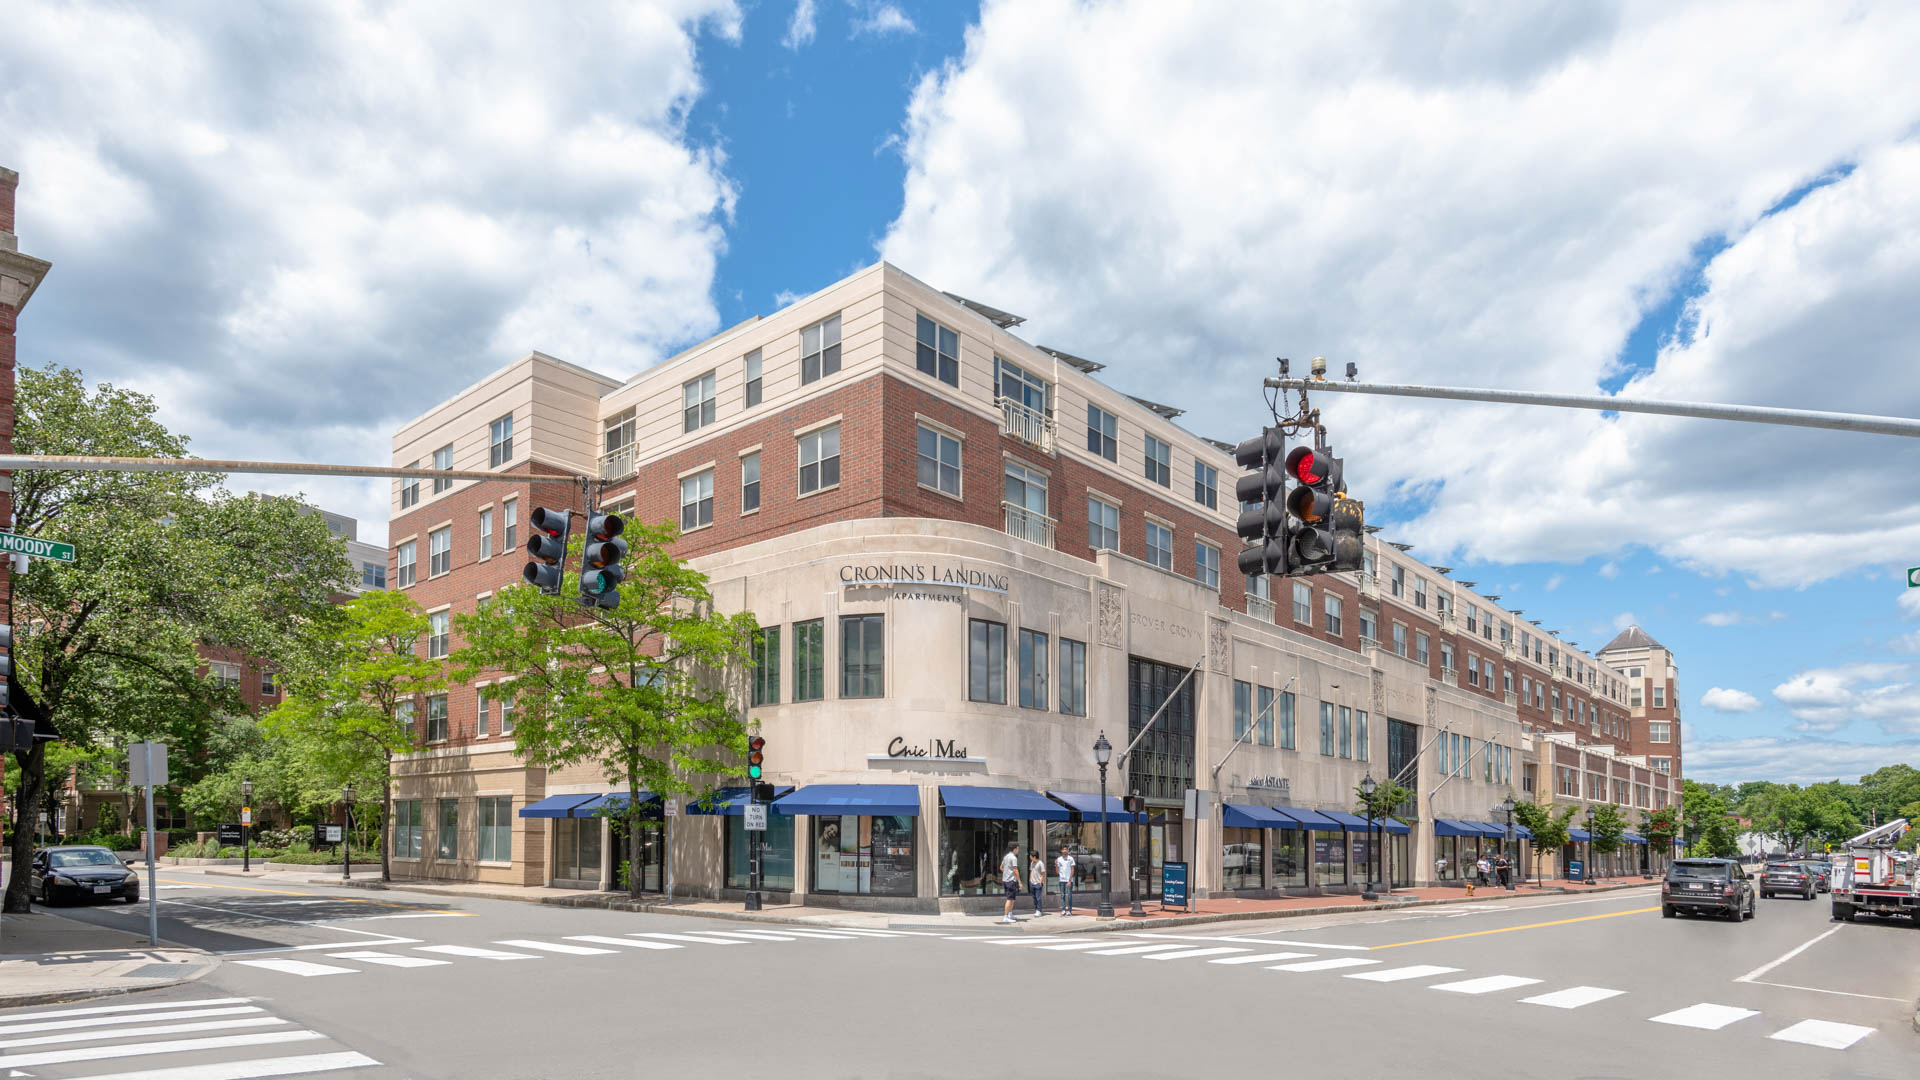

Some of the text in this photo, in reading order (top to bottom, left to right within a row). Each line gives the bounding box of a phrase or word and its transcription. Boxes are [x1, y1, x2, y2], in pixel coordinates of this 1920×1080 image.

[3, 535, 71, 560] MOODY ST
[840, 564, 1009, 591] CRONIN'S LANDING
[894, 591, 962, 604] APARTMENTS
[1130, 612, 1165, 632] GROVER
[935, 738, 967, 759] Med
